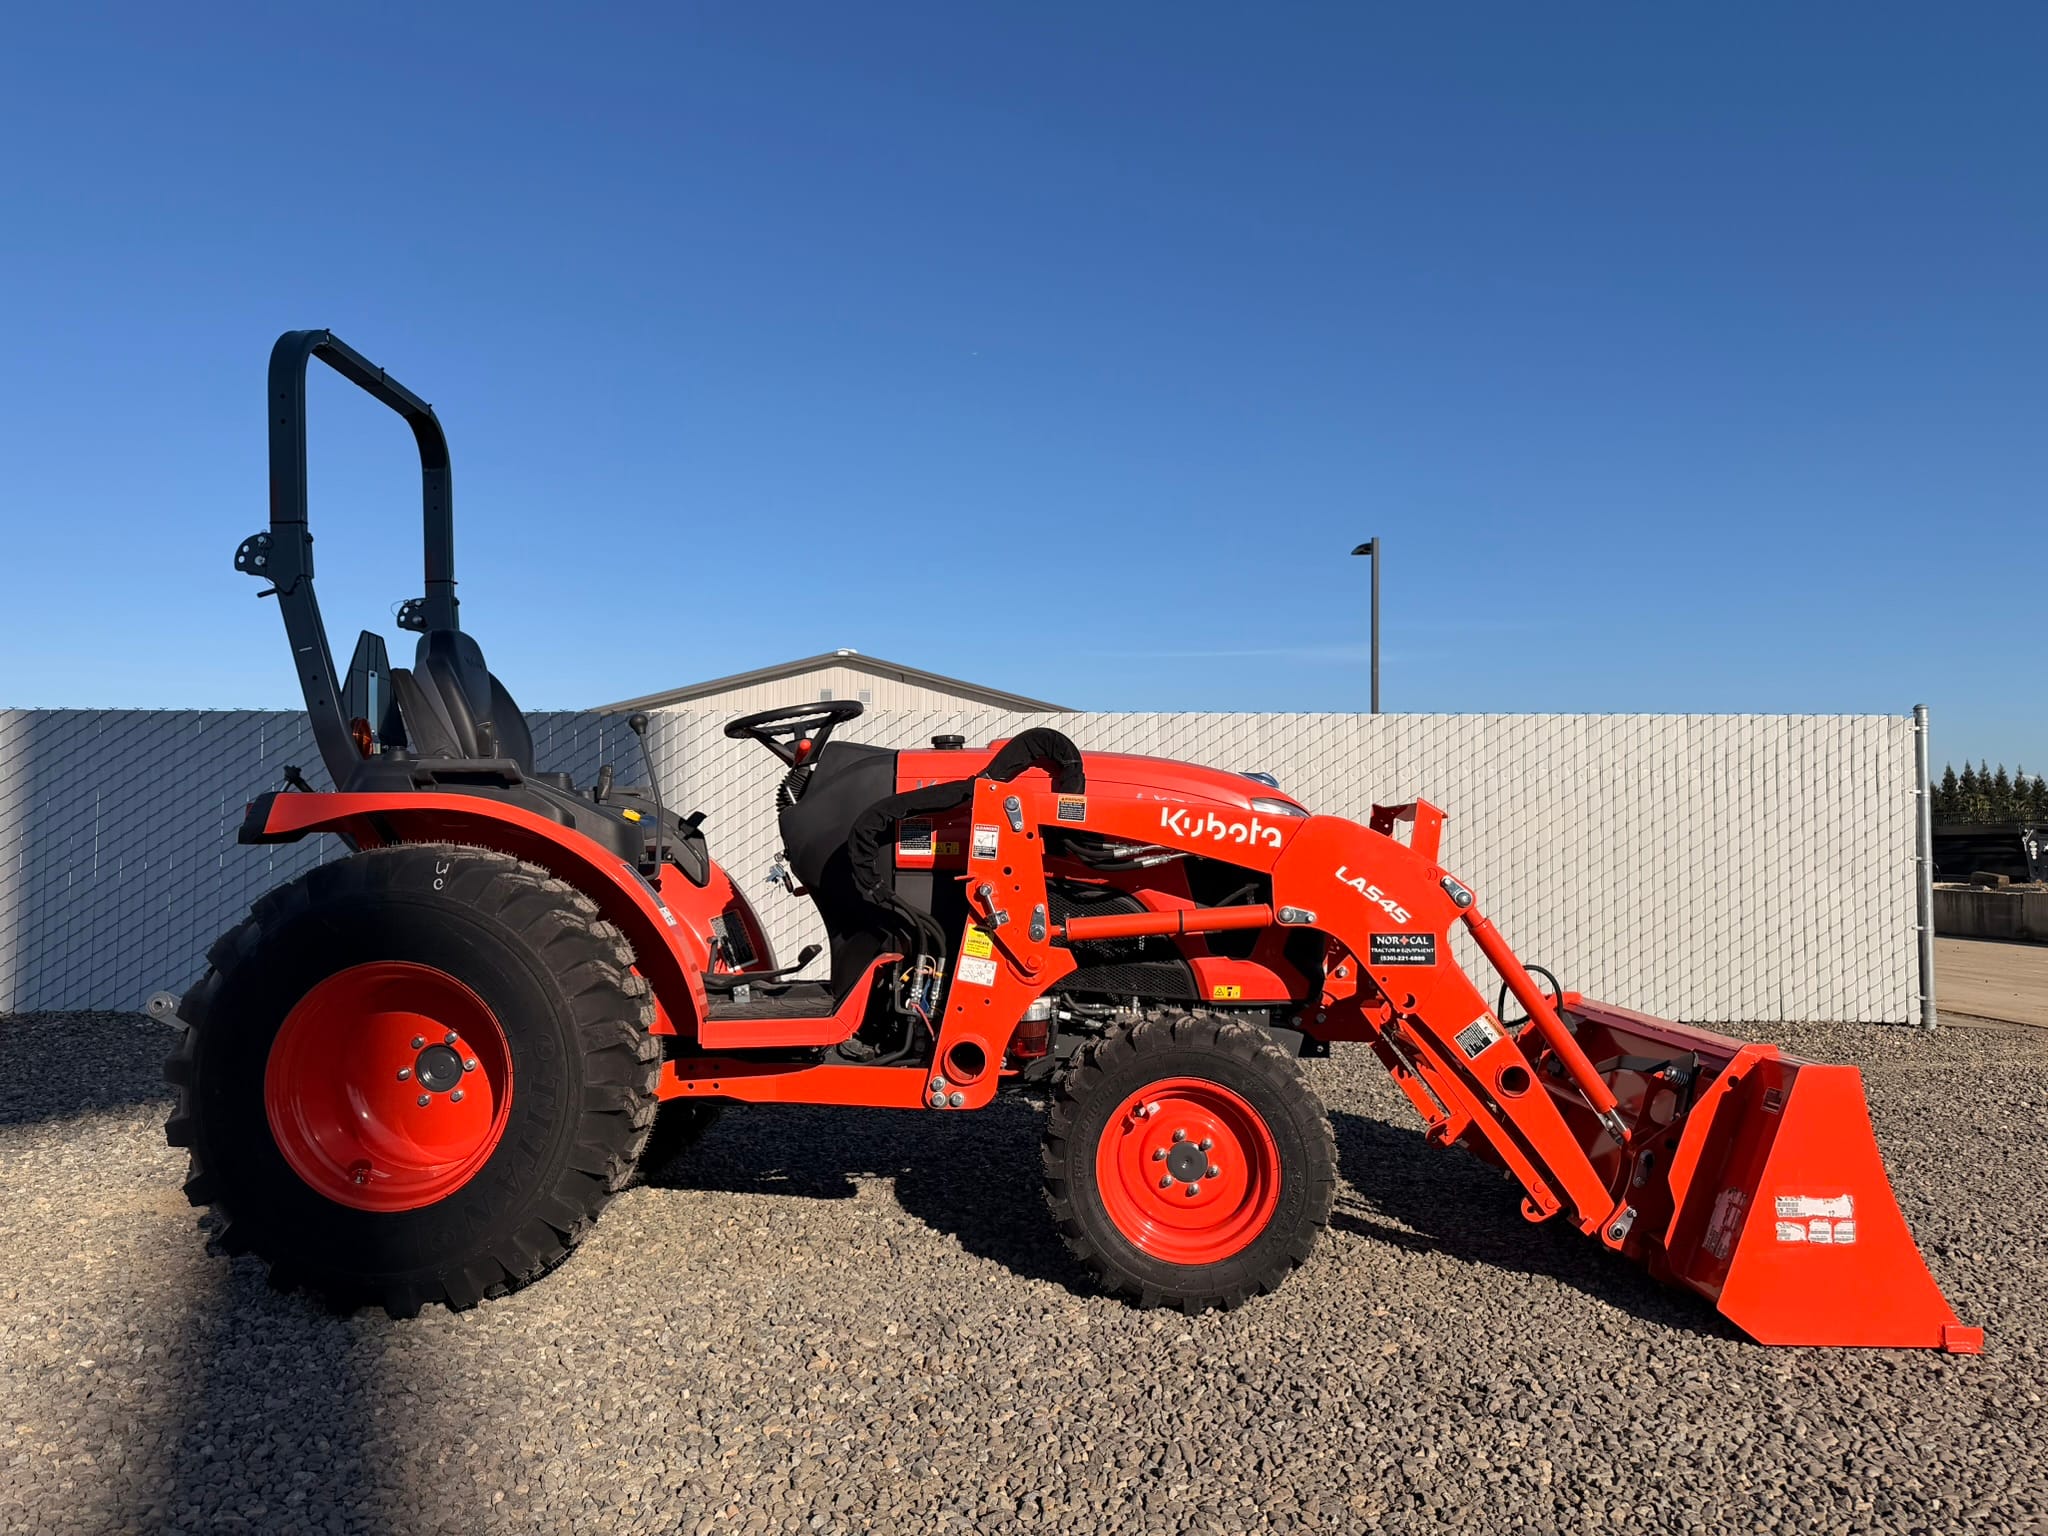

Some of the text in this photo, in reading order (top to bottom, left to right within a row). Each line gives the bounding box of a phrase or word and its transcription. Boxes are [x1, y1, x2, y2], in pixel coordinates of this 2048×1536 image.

[1160, 806, 1282, 848] Kubota
[1334, 865, 1413, 924] LA545
[1376, 936, 1429, 945] NOR CAL
[464, 1075, 561, 1234] TITAN
